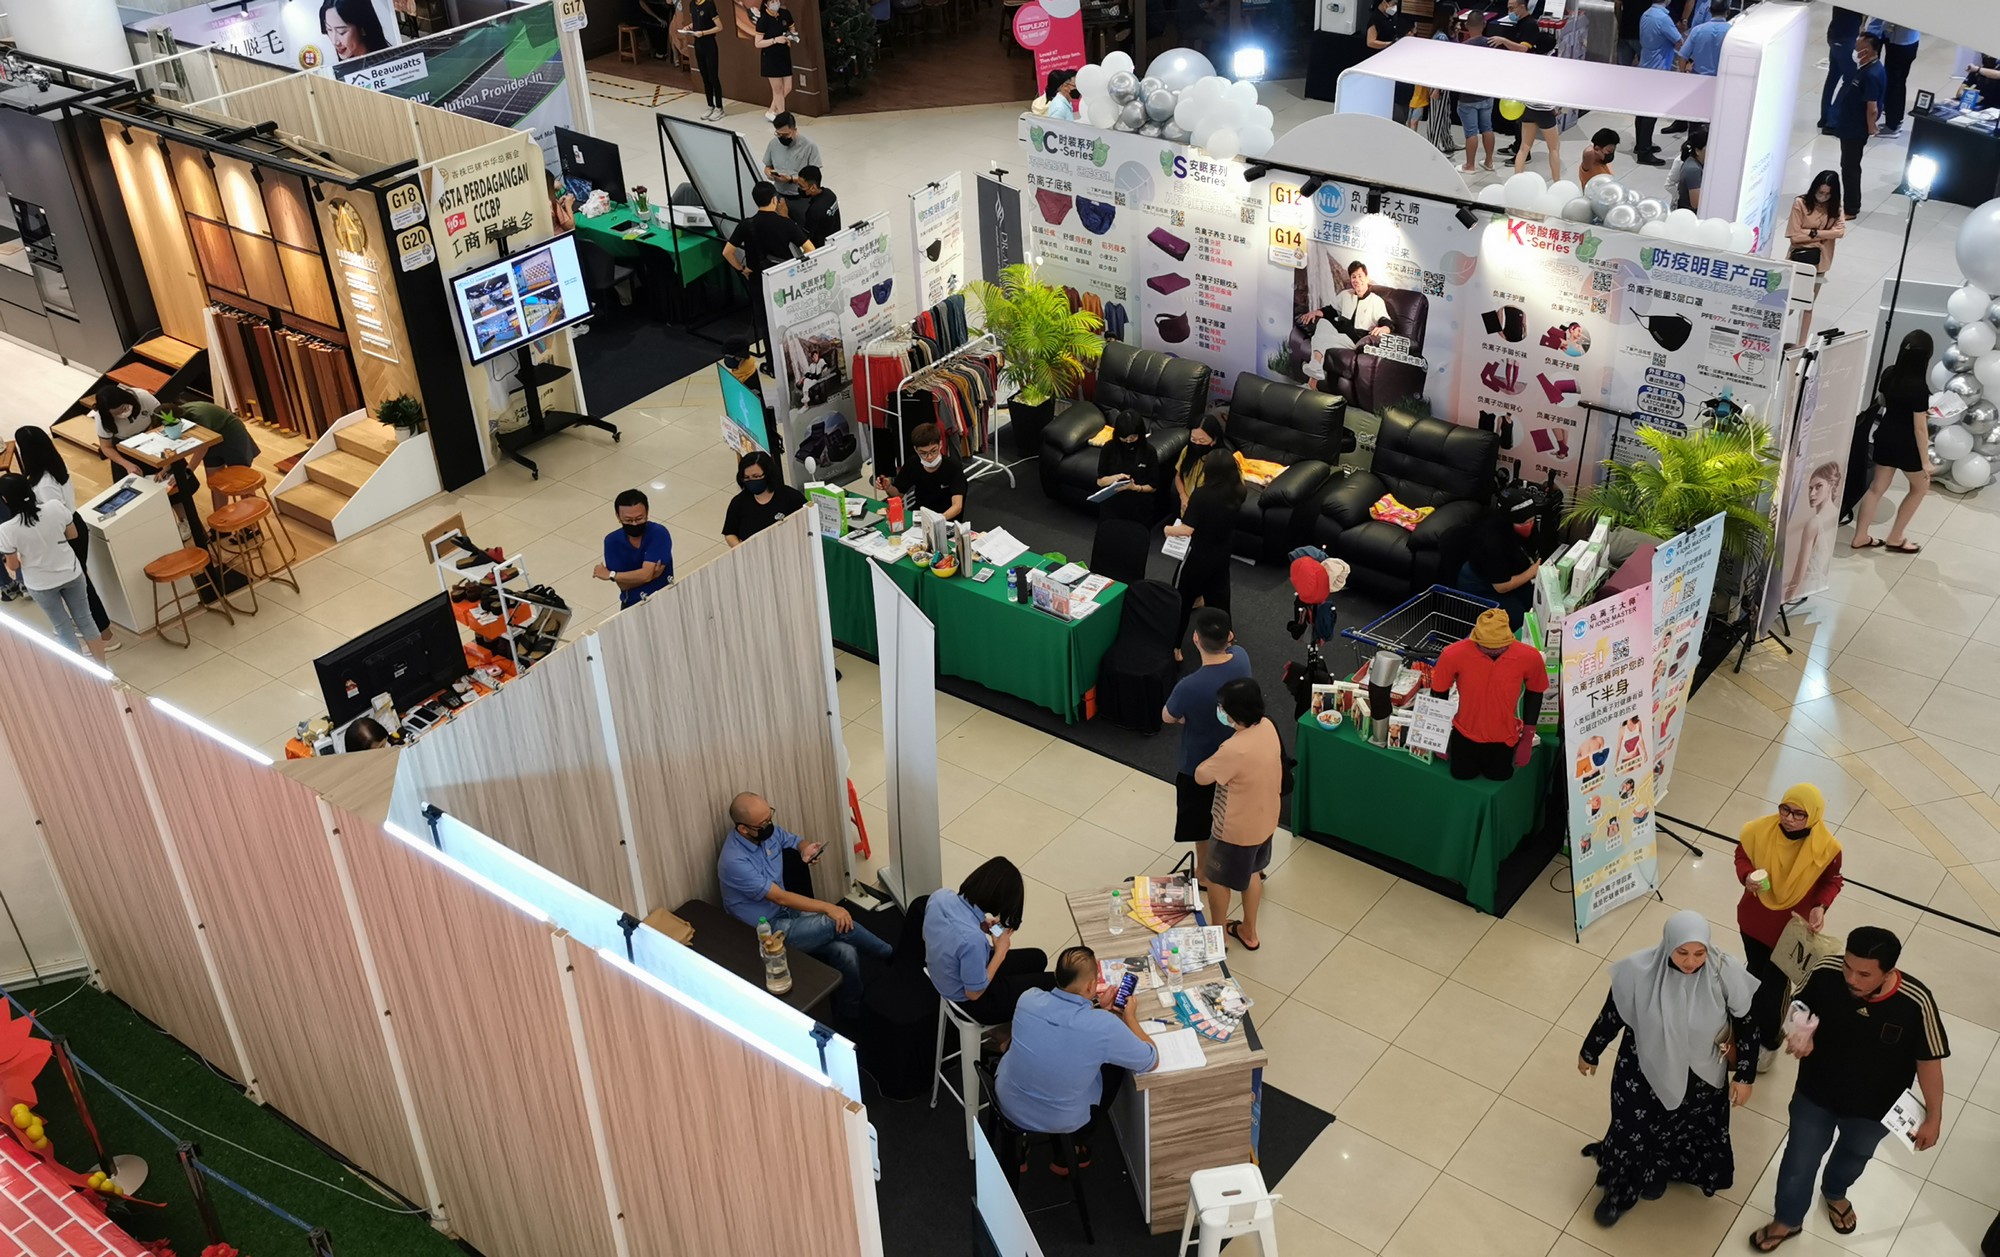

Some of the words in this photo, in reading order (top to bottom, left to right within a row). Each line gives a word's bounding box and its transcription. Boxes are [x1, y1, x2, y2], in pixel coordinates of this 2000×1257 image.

[563, 0, 581, 15] G17
[1019, 21, 1049, 32] TRIPLEJOY
[371, 57, 421, 79] Beauwatts
[373, 78, 387, 90] RE
[440, 94, 480, 113] lution
[481, 77, 530, 101] Provider
[531, 71, 543, 83] in
[405, 90, 430, 103] our
[1043, 131, 1058, 154] C
[1058, 134, 1095, 151] 时装系列
[1060, 146, 1094, 161] -Series
[1173, 155, 1188, 179] S
[1189, 159, 1228, 177] 安眠系列
[464, 163, 530, 204] PERDAGANGAN
[1027, 173, 1072, 192] 负离子底裤
[1190, 172, 1226, 187] -Series
[392, 187, 416, 209] G18
[1275, 187, 1302, 206] G12
[474, 197, 501, 224] CCCBP
[1351, 204, 1358, 213] N
[1383, 210, 1419, 225] MASTER
[402, 229, 426, 251] G20
[1275, 228, 1302, 247] G14
[1507, 218, 1527, 246] K
[1525, 224, 1585, 245] 除酸痛系列
[1313, 229, 1411, 258] 让全世界的人起来
[1527, 238, 1570, 254] -Series
[1652, 248, 1768, 289] 防疫明星产品
[1627, 283, 1704, 307] 负离子能量3层口罩
[1741, 339, 1771, 353] 97.1%
[1589, 597, 1636, 622] 负离子大师
[1589, 622, 1594, 631] N
[1595, 615, 1611, 628] IONS
[1611, 606, 1637, 623] MASTER
[1571, 656, 1645, 697] 负离子底裤呵护您的
[1587, 678, 1630, 709] 下半身
[1573, 689, 1644, 728] 人类知道负离子对健康有益
[1579, 703, 1638, 735] 已超过100多年的历史
